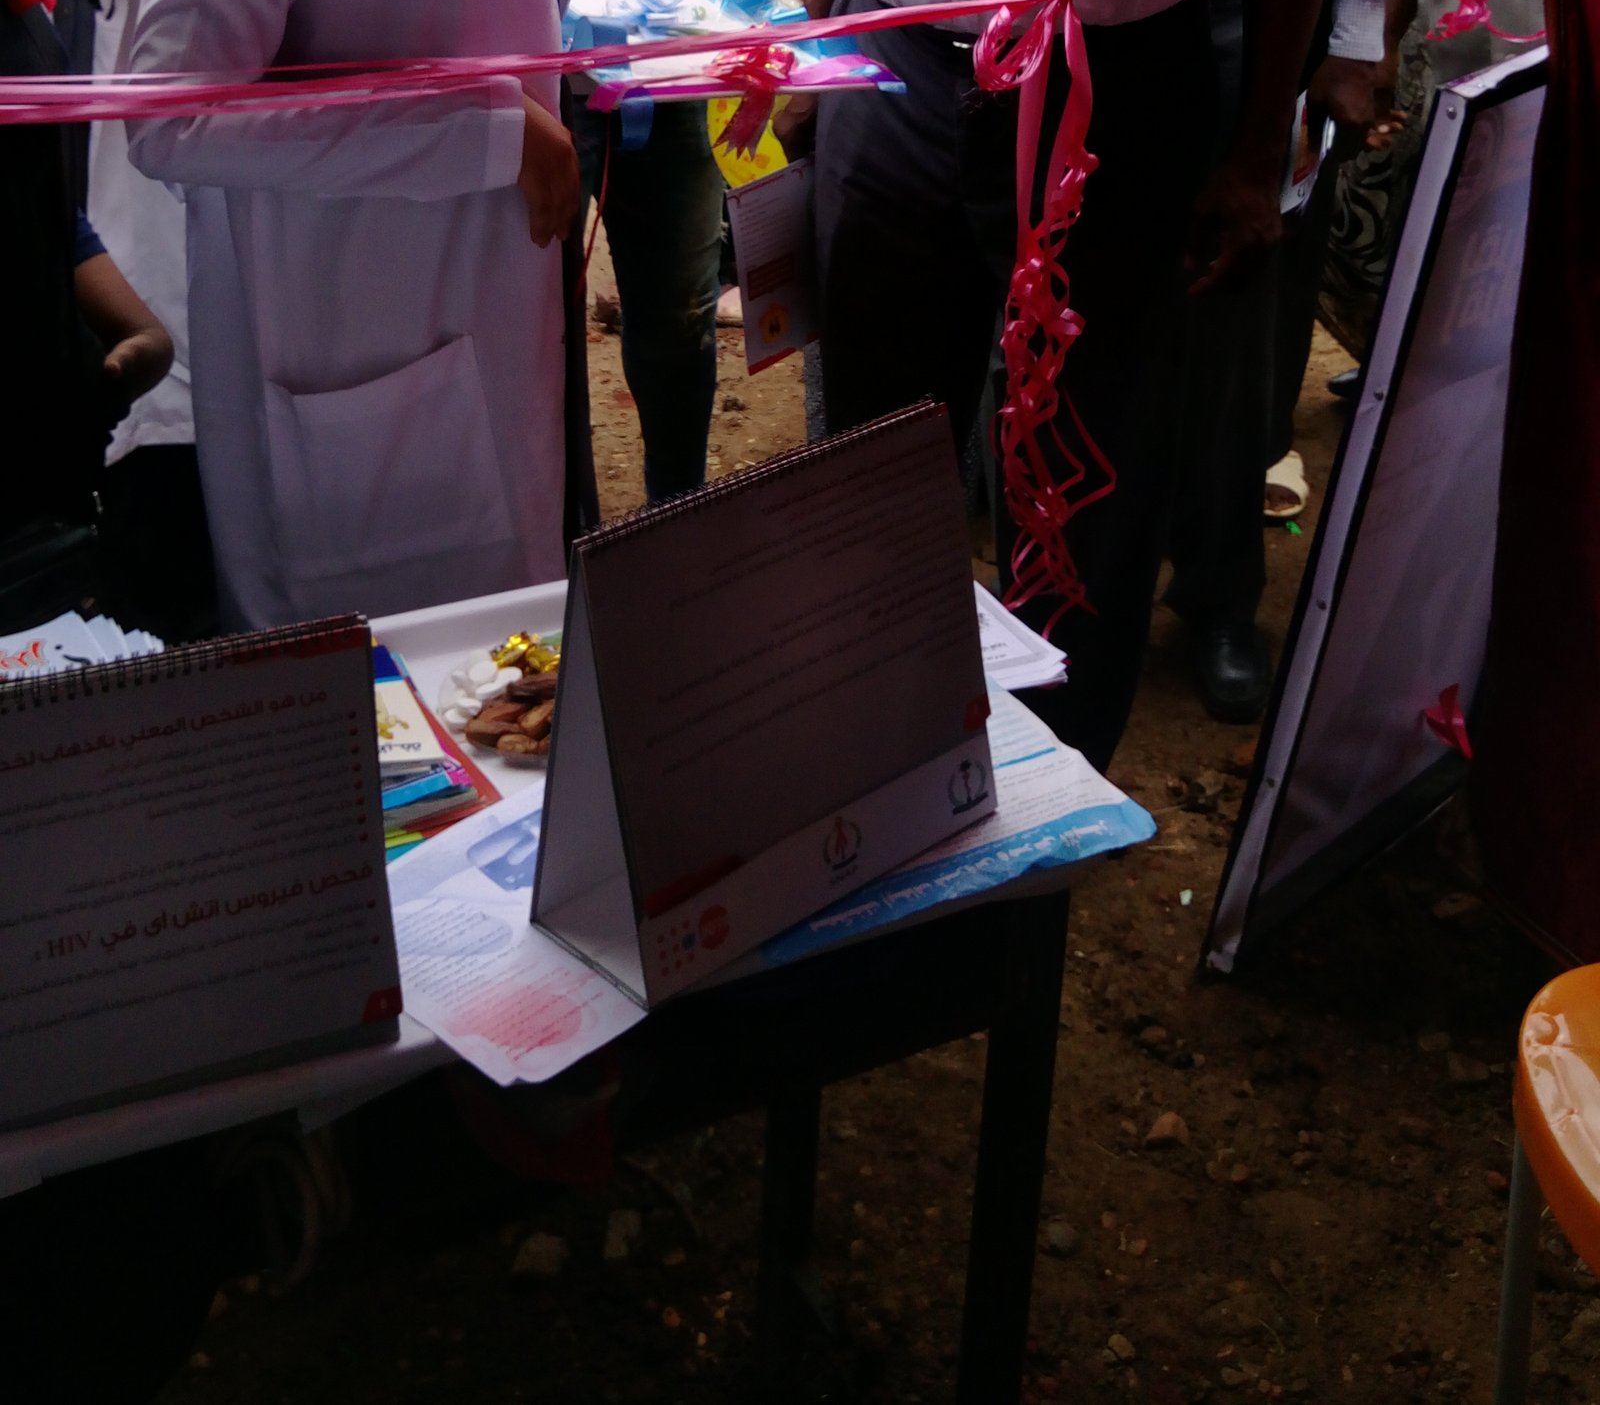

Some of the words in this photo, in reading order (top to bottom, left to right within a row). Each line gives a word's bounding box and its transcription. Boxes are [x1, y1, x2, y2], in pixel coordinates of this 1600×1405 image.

[268, 695, 296, 713] هو
[299, 689, 328, 708] من
[190, 699, 264, 733] الشخص
[308, 862, 374, 896] فحص
[224, 881, 304, 916] فيروس
[46, 928, 92, 960] HIV
